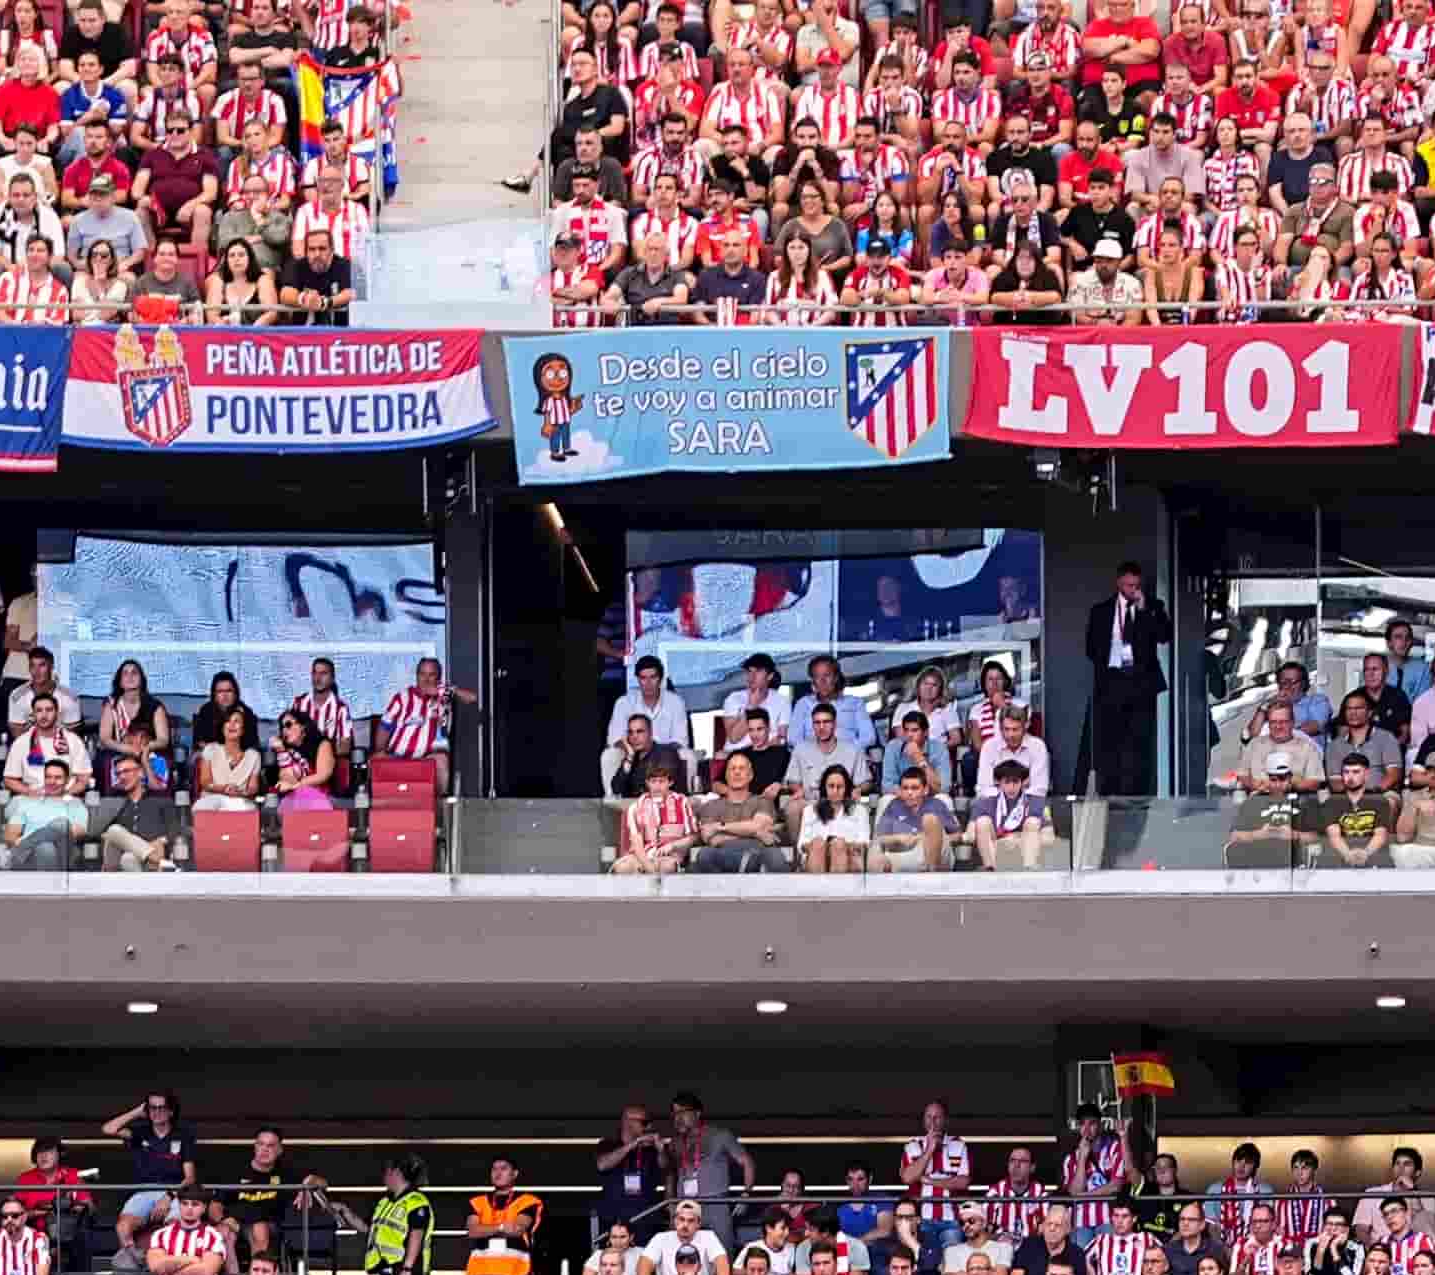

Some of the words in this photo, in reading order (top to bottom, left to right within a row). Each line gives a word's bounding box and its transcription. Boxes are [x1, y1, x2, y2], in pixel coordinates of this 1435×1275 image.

[205, 343, 270, 377] PEÑA
[272, 337, 411, 376] ATLÉTICA
[415, 339, 442, 373] DE
[598, 352, 711, 386] Desde
[714, 354, 741, 381] el
[751, 350, 828, 380] cielo
[593, 391, 625, 418] te
[634, 387, 692, 417] voy
[695, 387, 719, 411] a
[724, 383, 840, 412] animar
[997, 338, 1361, 437] LV101
[205, 388, 444, 437] PONTEVEDRA
[667, 420, 773, 457] SARA
